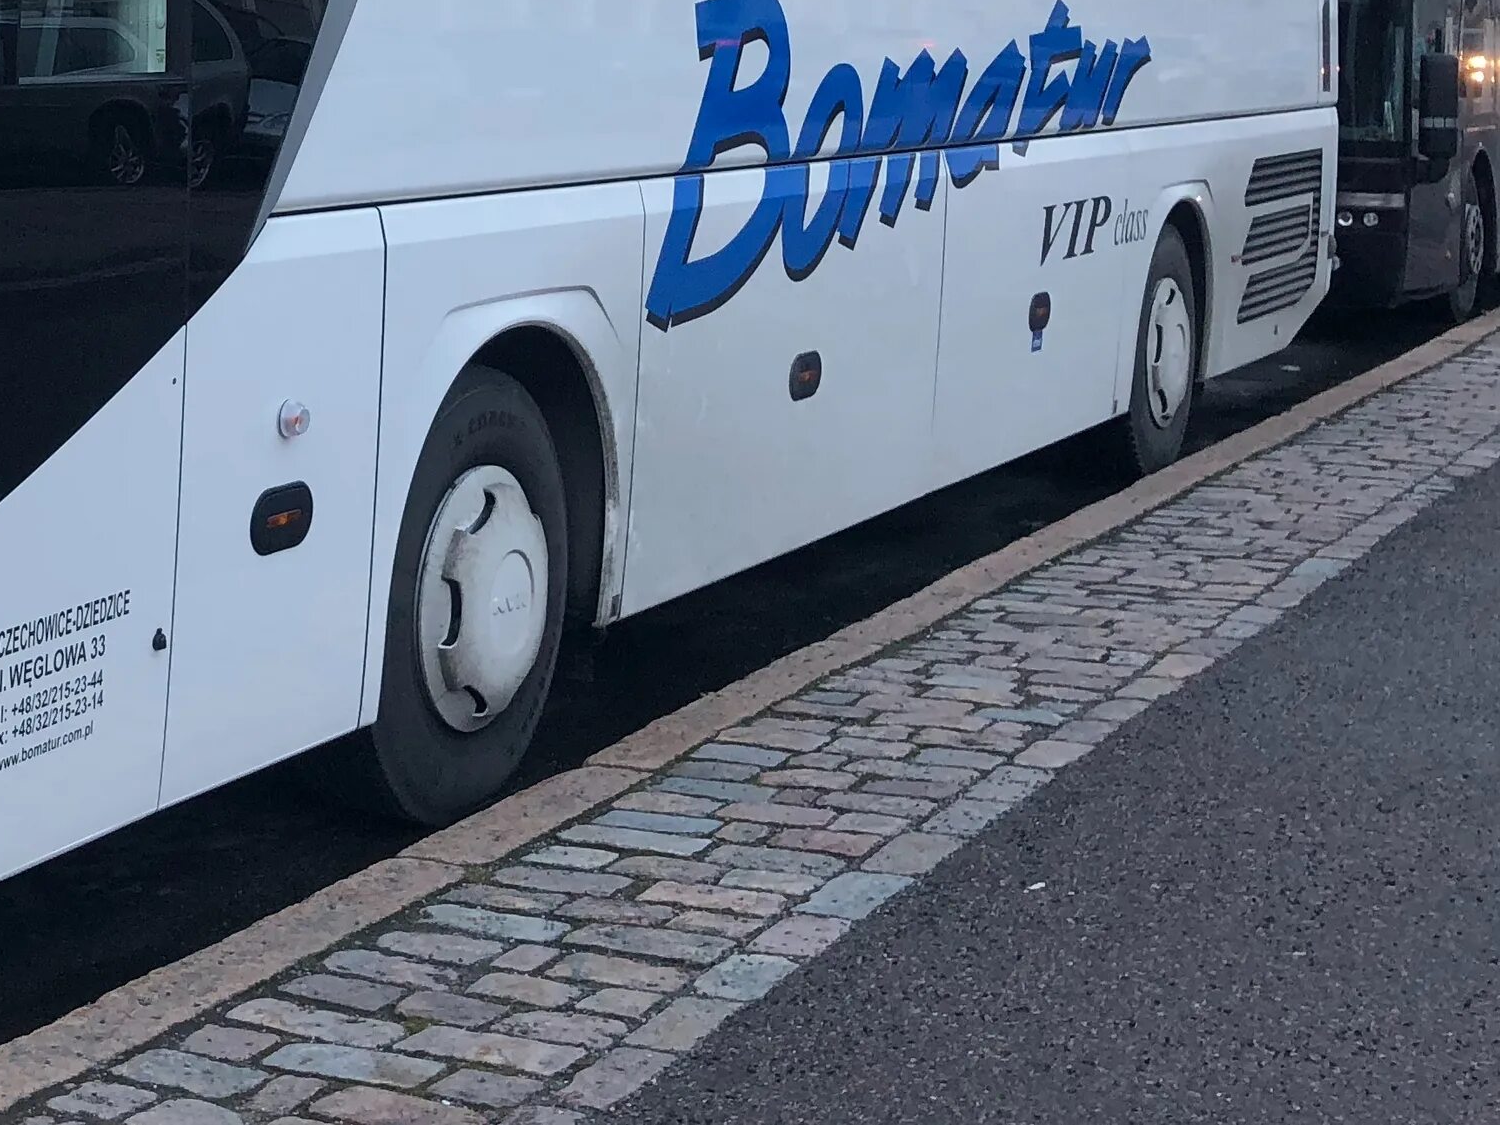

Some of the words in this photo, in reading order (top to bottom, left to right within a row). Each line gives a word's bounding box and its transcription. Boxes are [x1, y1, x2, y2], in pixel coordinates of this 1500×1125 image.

[1040, 195, 1112, 267] VIP
[1114, 198, 1149, 246] class
[9, 640, 87, 688] WĘGLOWA
[90, 634, 106, 660] 33
[11, 669, 104, 716] +48/32/215-23-44
[11, 689, 104, 738] +48/32/215-23-14
